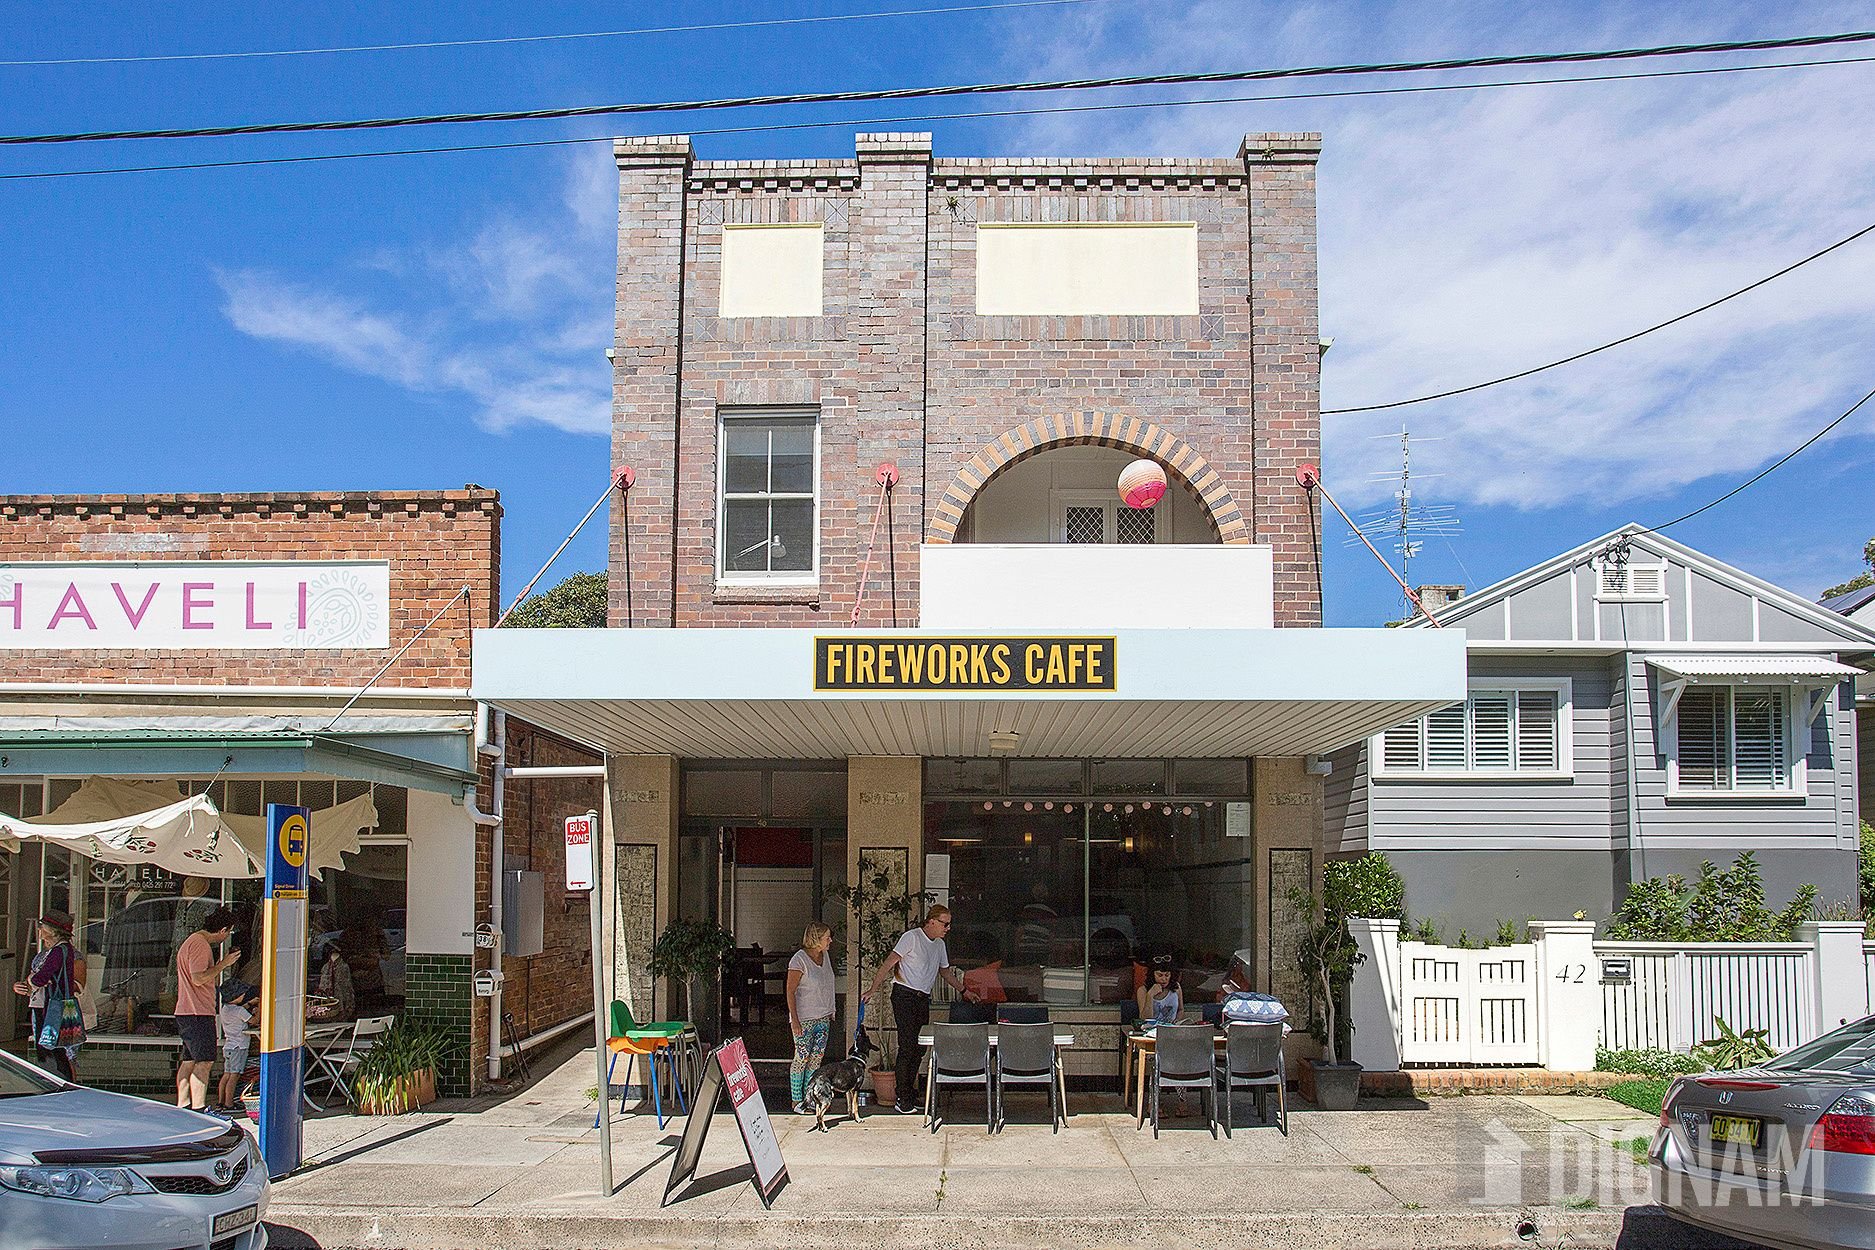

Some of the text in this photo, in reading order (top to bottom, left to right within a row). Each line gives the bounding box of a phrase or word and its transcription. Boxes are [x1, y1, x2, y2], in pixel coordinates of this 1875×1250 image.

[827, 643, 1104, 685] FIREWORKS CAFE
[569, 822, 587, 833] BUS
[567, 833, 590, 844] ZONE
[95, 867, 172, 880] HAELI
[1555, 964, 1586, 984] 42
